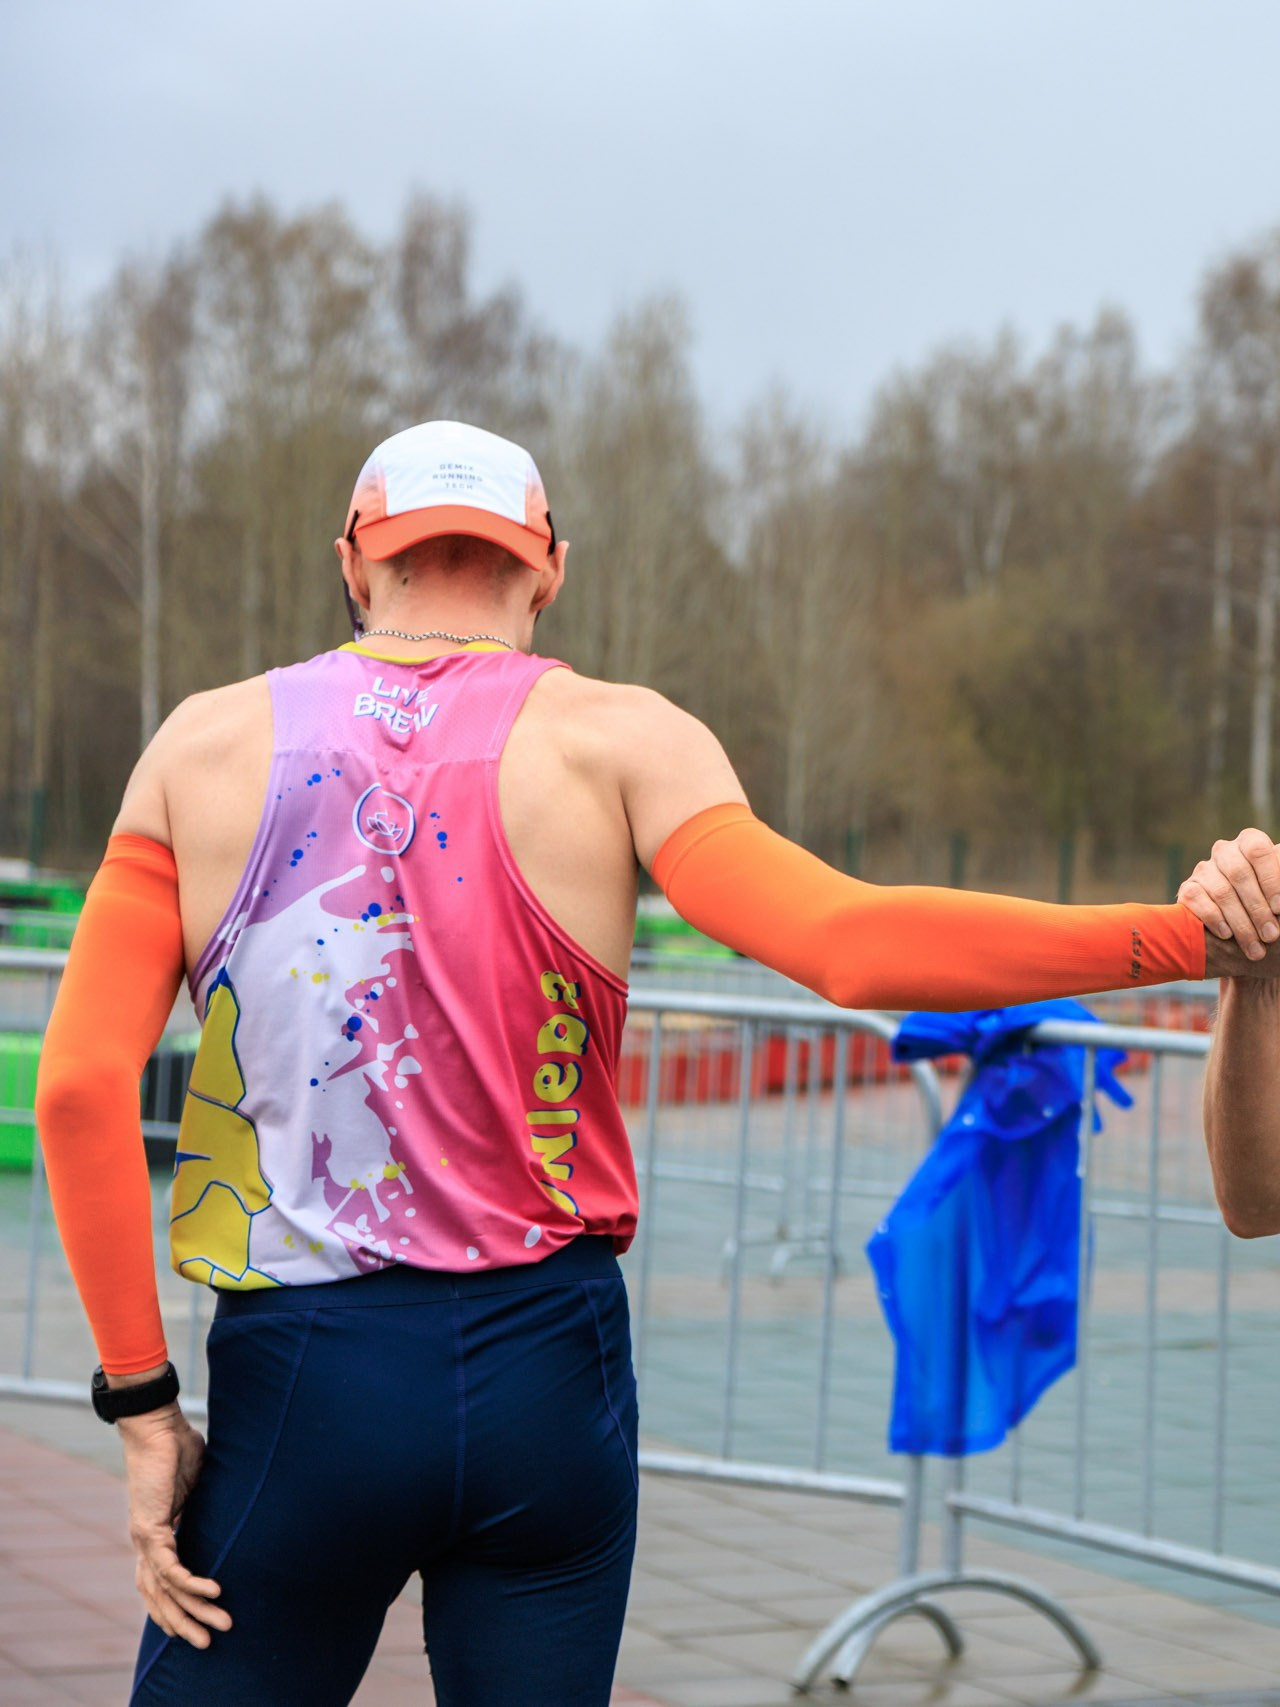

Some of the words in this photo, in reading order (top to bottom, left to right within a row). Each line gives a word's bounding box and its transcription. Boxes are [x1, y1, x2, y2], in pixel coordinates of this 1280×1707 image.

[432, 473, 483, 482] RUNNING
[444, 482, 474, 490] TECH
[353, 693, 439, 734] BREW
